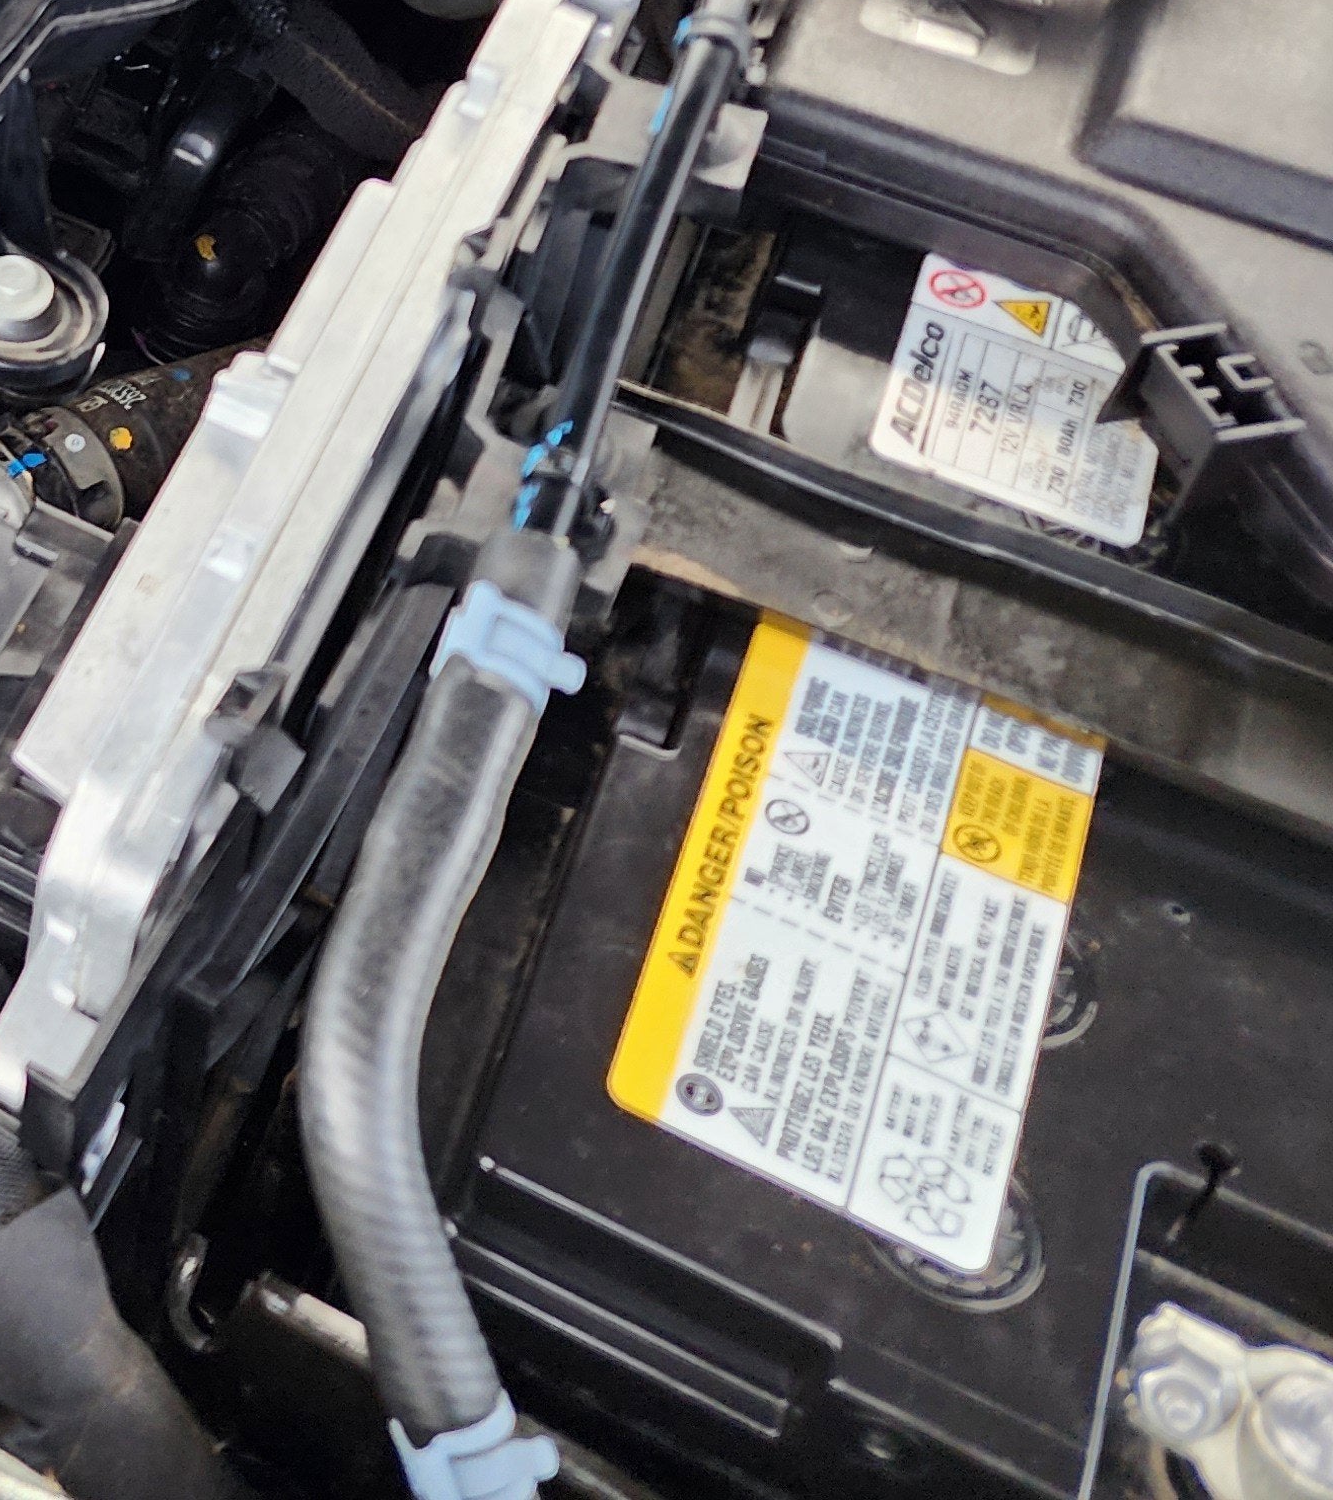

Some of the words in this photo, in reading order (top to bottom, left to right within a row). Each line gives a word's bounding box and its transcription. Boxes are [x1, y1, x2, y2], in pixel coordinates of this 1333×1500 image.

[889, 319, 946, 445] ACDelco
[967, 378, 1004, 438] 7287
[1066, 378, 1087, 409] 730
[998, 427, 1021, 457] 12V
[676, 710, 774, 951] DANGER/POISON
[692, 1016, 725, 1073] SHIELD
[715, 999, 755, 1083] EXPLOSIVE
[738, 952, 769, 1002] GASES
